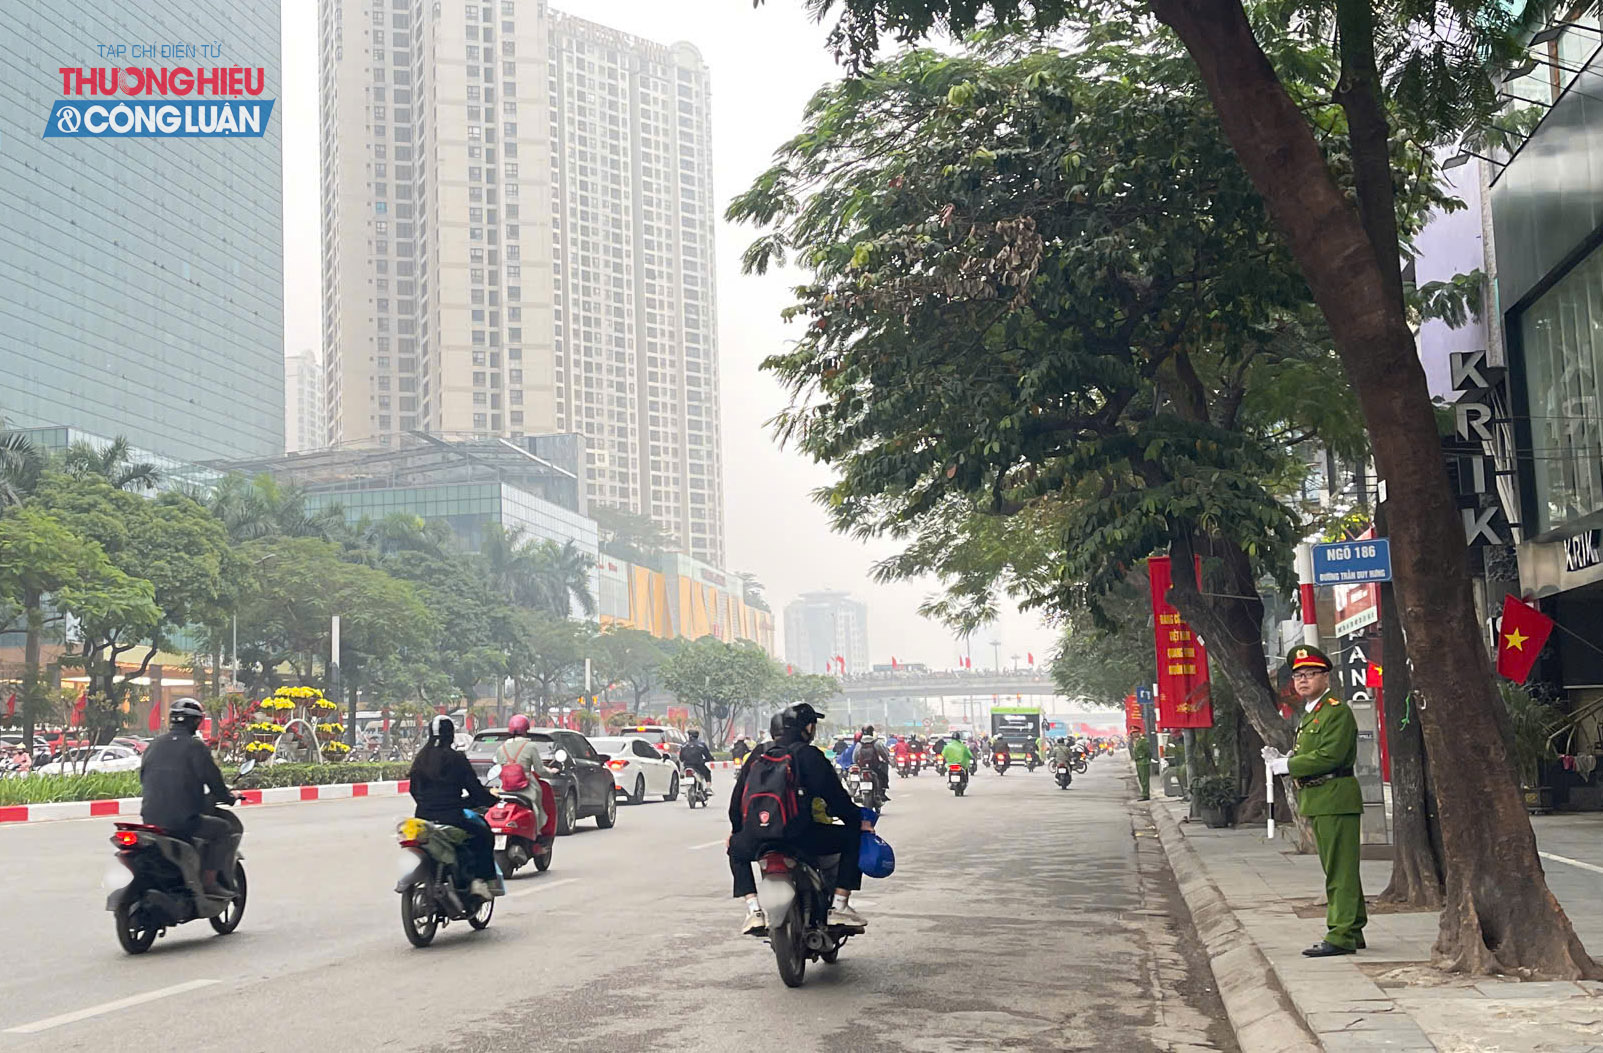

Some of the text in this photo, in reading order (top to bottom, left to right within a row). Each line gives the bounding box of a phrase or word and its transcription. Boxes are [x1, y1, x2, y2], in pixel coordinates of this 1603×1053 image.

[1450, 350, 1502, 547] KRIK
[1326, 545, 1376, 561] NGÕ 186
[1563, 529, 1596, 571] KRIK
